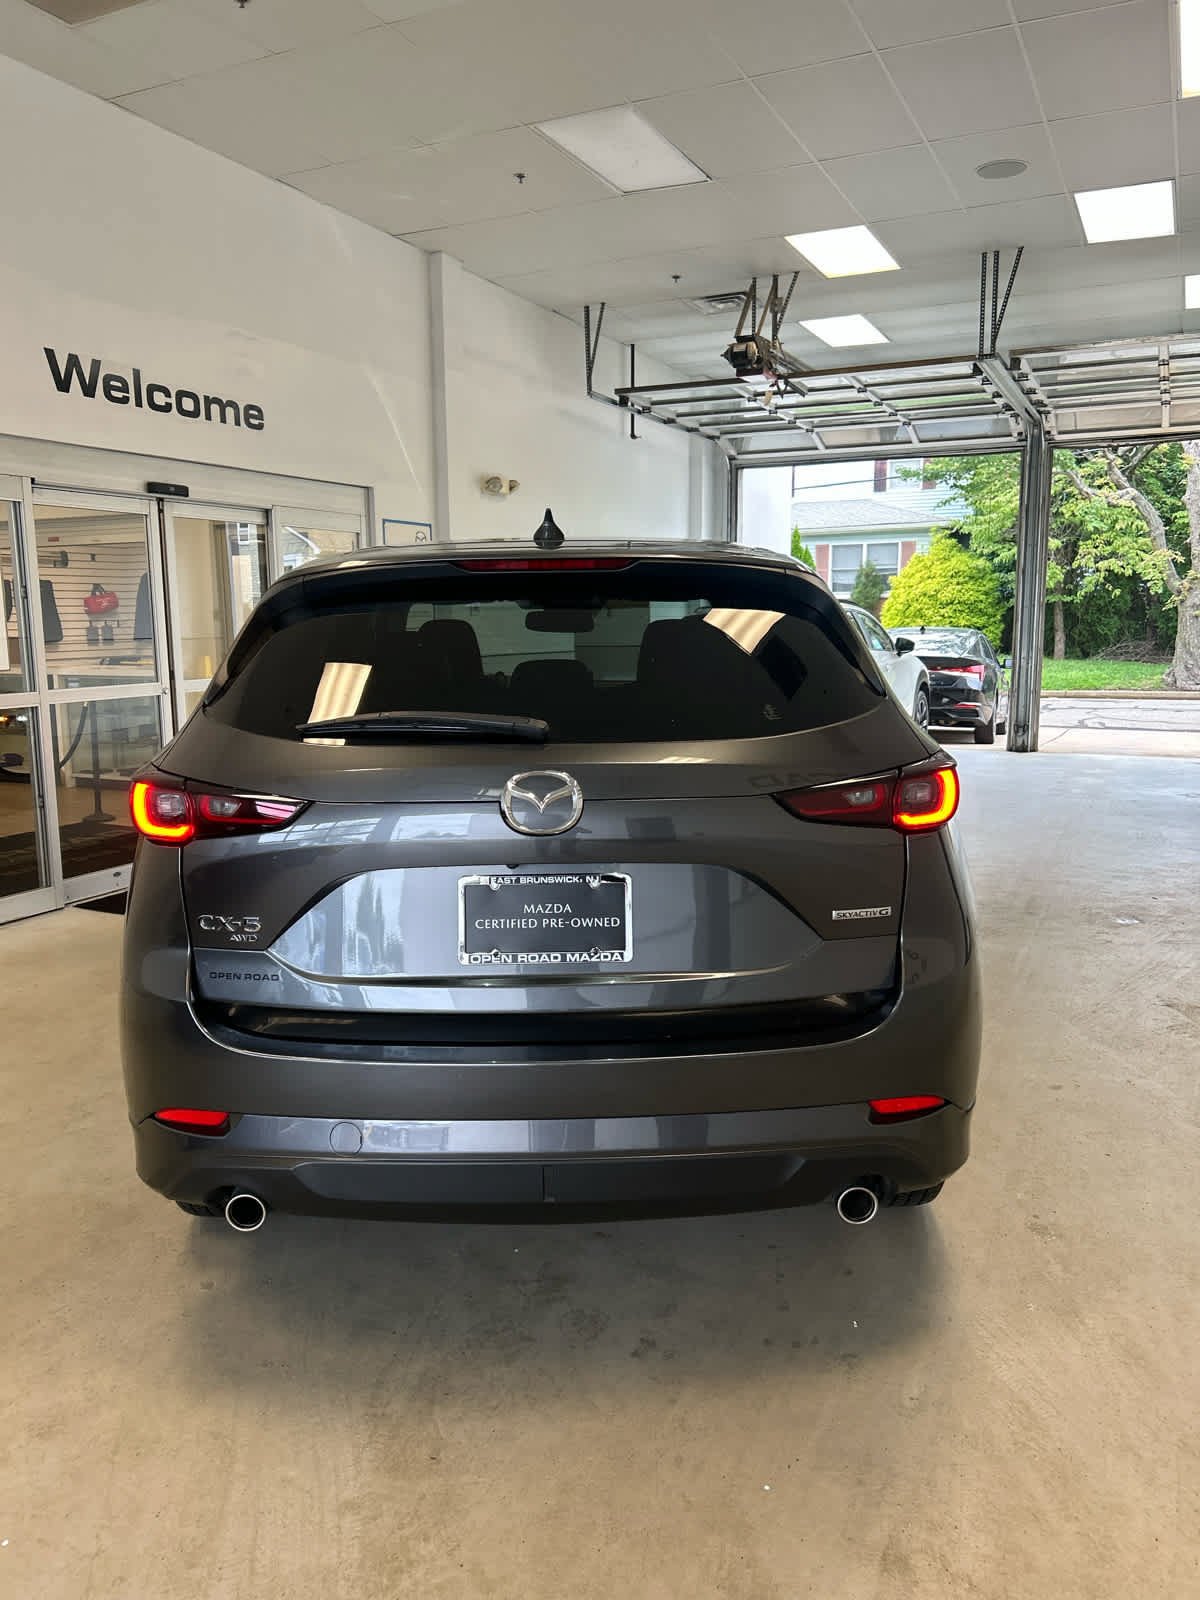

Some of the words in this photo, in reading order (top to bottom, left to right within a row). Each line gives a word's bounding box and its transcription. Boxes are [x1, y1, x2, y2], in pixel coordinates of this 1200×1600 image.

[43, 347, 265, 430] Welcome
[491, 877, 517, 885] EAST
[523, 903, 572, 914] MAZDA
[199, 914, 262, 932] CX-5
[475, 919, 538, 929] CERTIFIED
[542, 917, 621, 928] PRE-OWNED
[230, 934, 258, 942] AWD
[470, 954, 513, 964] OPEN
[517, 953, 562, 963] ROAD
[566, 952, 624, 962] MAZDA
[209, 971, 241, 980] OPEN
[244, 973, 280, 981] ROAD
